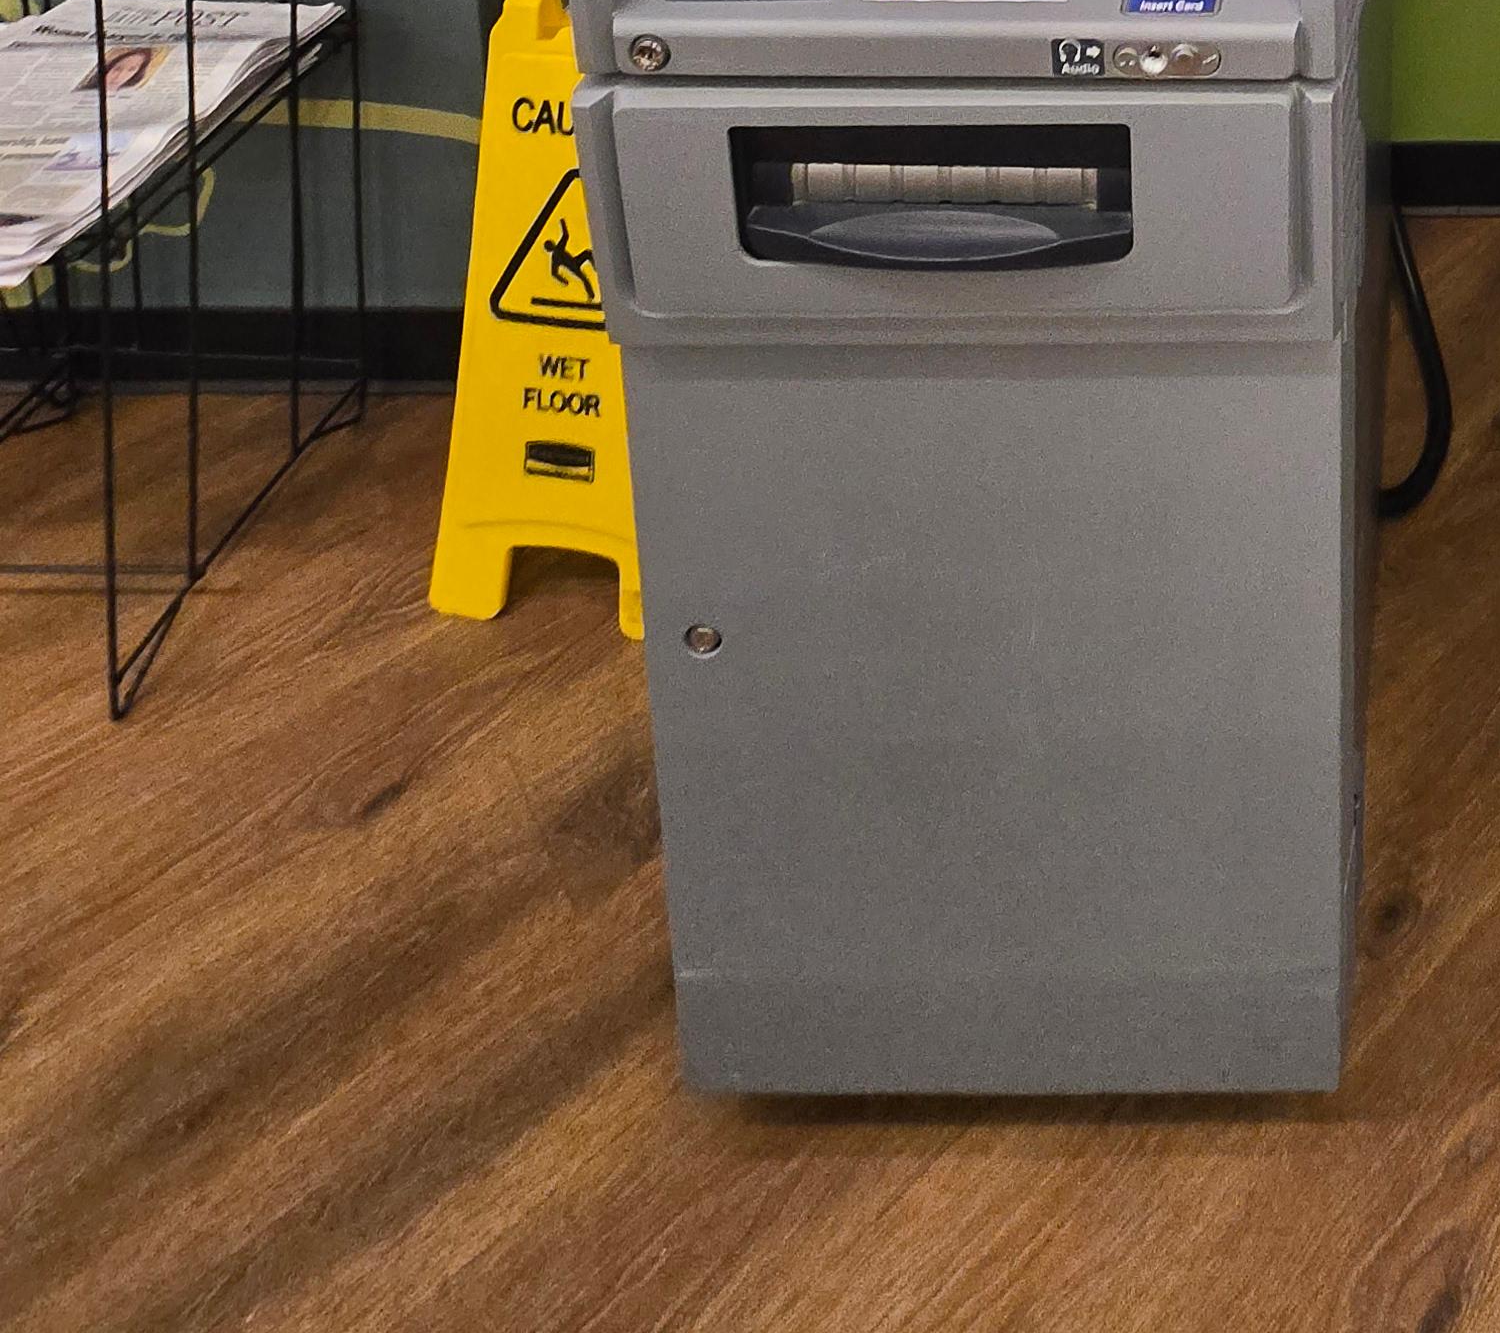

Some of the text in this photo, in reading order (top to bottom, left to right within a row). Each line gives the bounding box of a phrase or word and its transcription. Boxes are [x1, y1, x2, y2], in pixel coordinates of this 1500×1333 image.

[1140, 0, 1205, 12] Insert Card
[1061, 62, 1101, 75] Audio
[539, 354, 591, 382] WET
[523, 386, 602, 418] FLOOR
